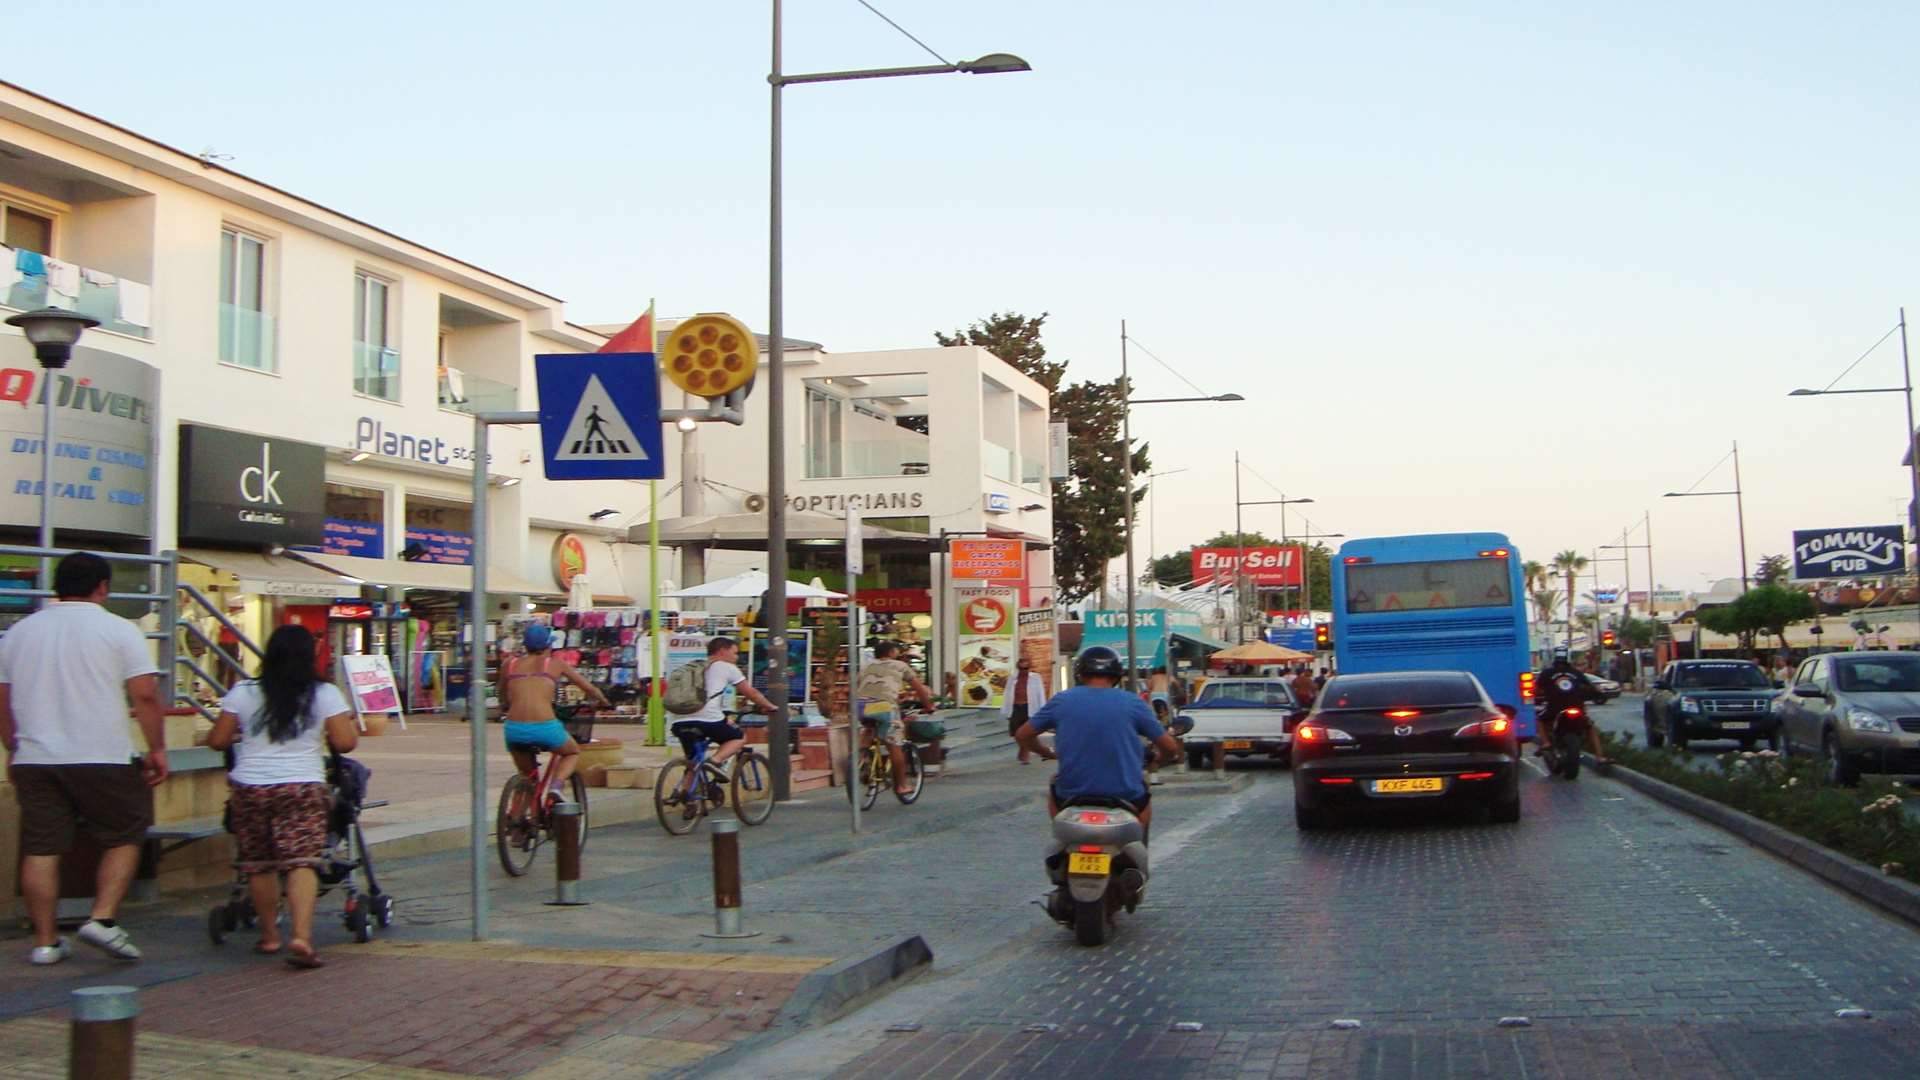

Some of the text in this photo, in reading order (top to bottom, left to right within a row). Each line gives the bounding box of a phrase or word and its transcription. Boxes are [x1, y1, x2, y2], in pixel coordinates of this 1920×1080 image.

[357, 416, 448, 465] Planet
[793, 492, 923, 512] OPTICIANS
[1199, 550, 1293, 570] BuySell
[1831, 559, 1868, 572] PUB
[1095, 613, 1157, 627] KIOSK
